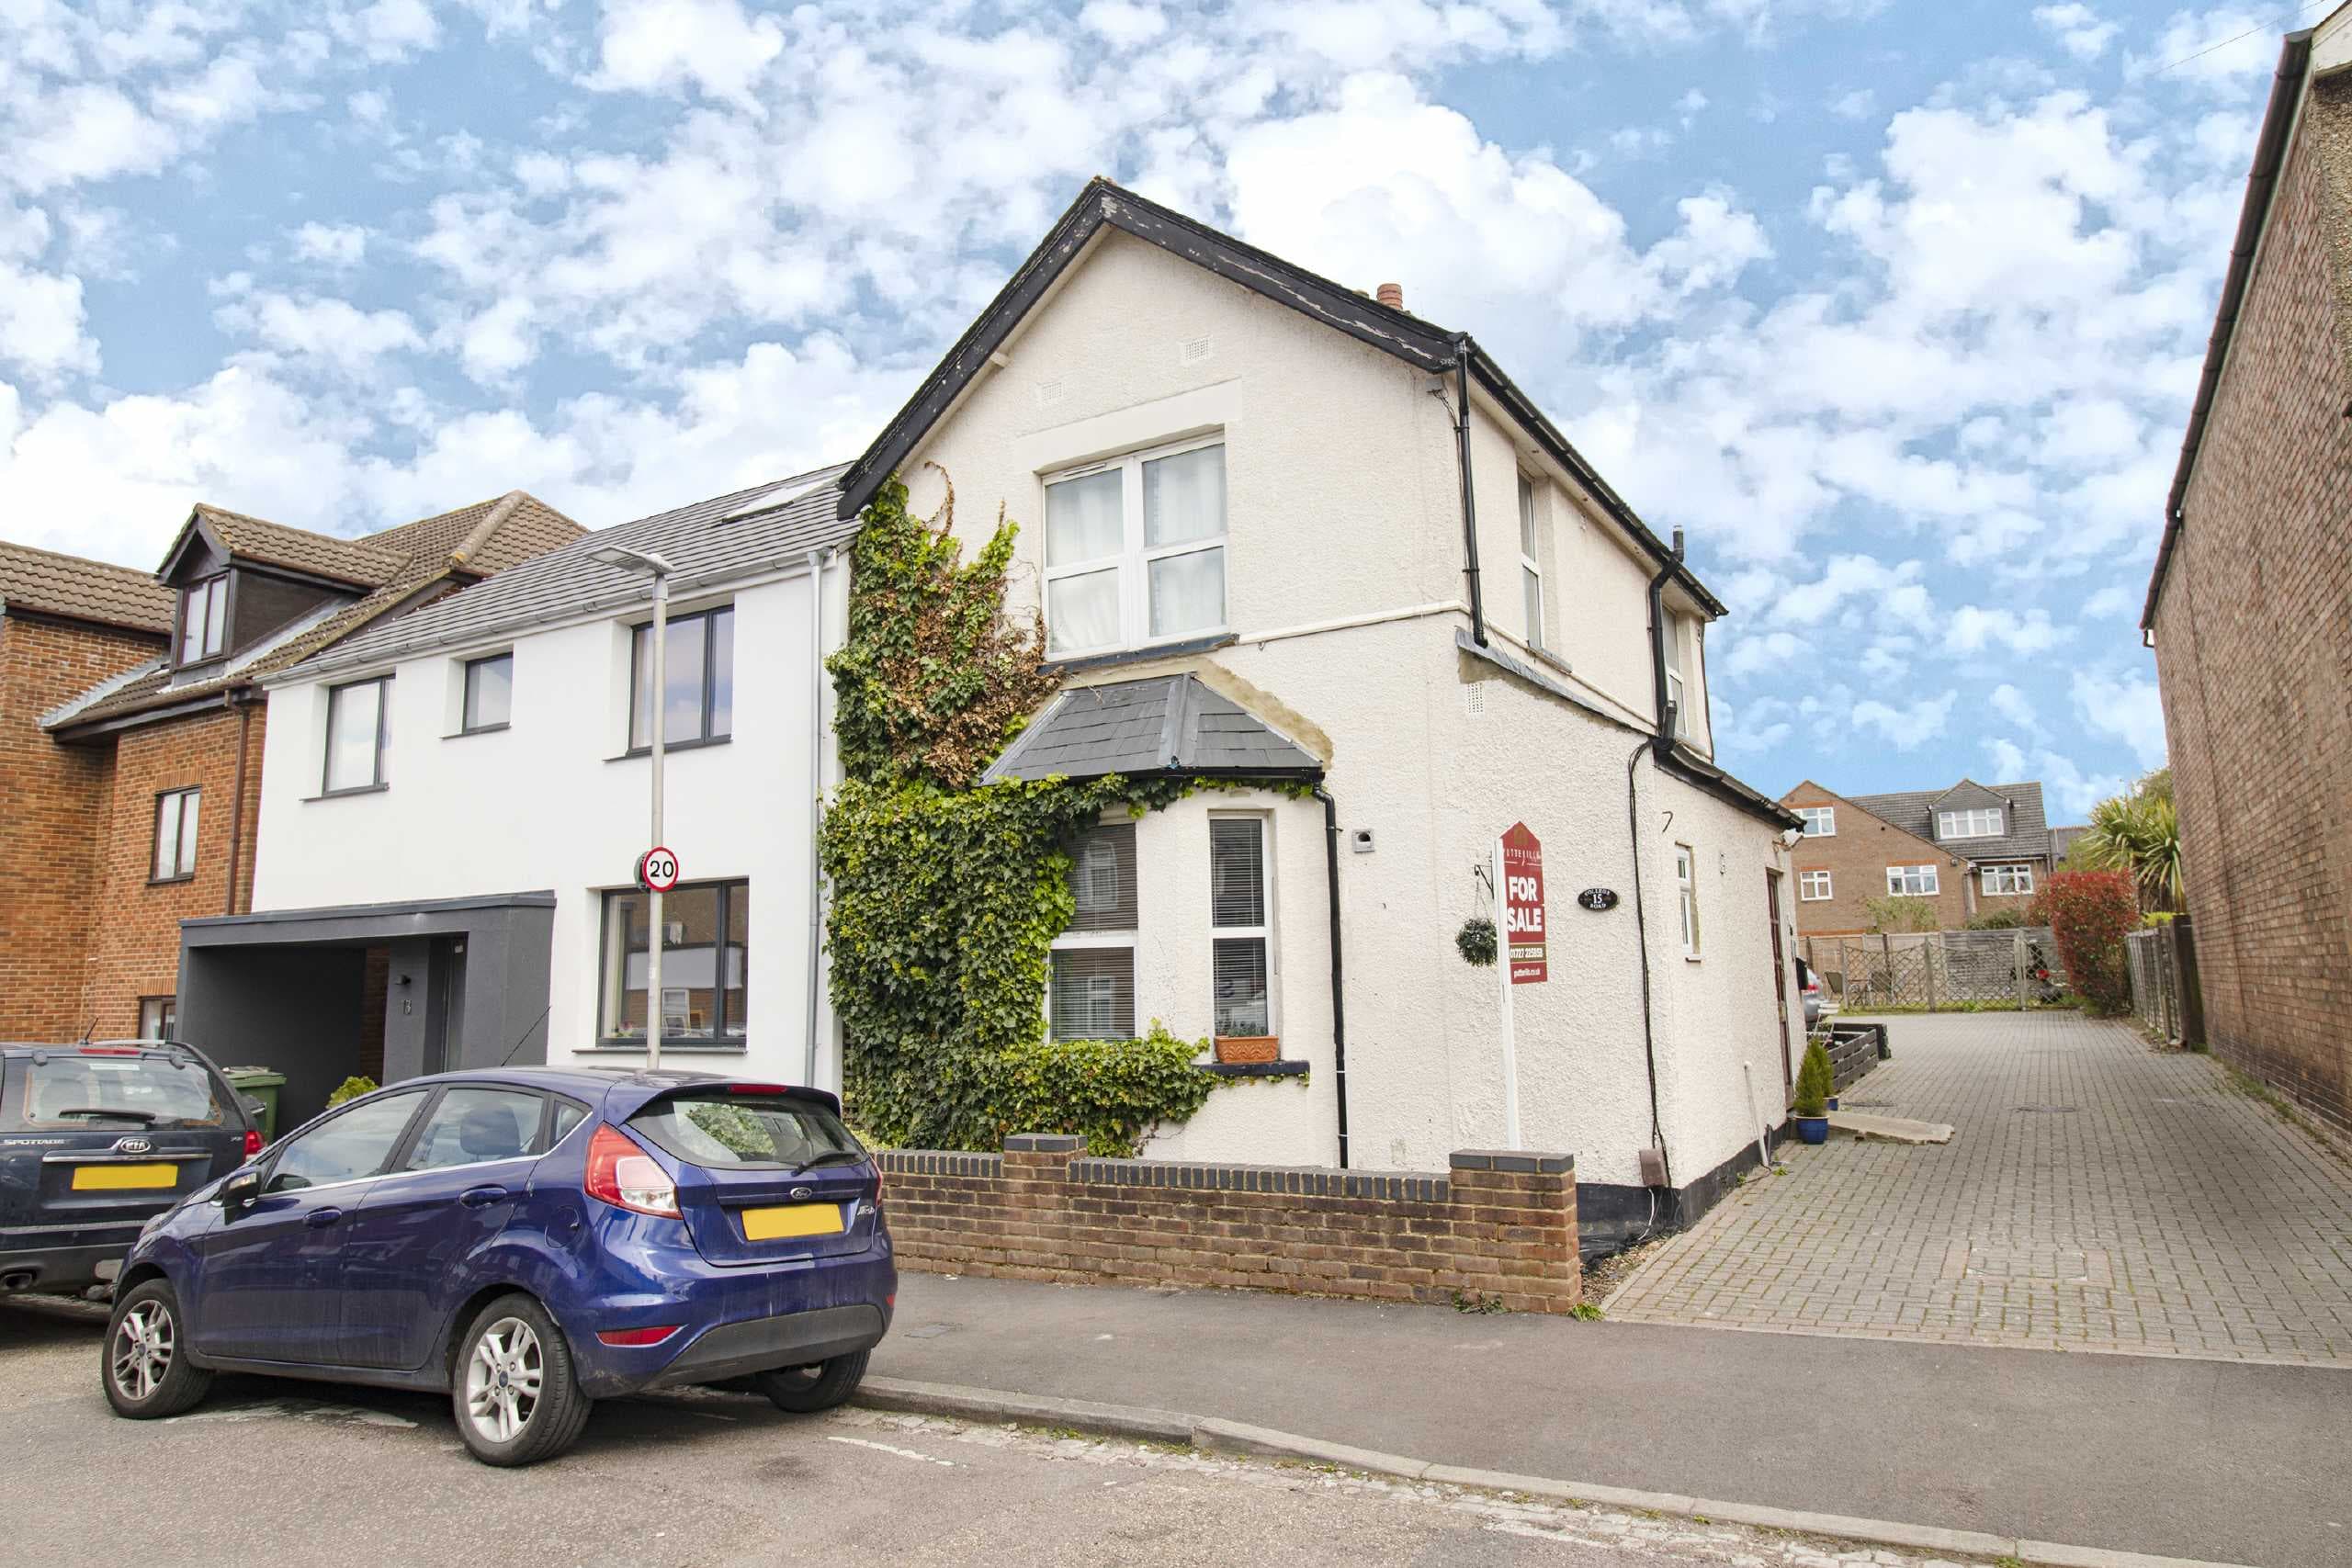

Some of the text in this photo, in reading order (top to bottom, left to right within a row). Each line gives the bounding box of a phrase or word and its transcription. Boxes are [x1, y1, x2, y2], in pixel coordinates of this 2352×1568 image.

[650, 860, 674, 878] 20
[1509, 876, 1538, 901] FOR
[1593, 894, 1602, 904] 15
[1507, 908, 1542, 931] SALE
[125, 1141, 146, 1151] KIA
